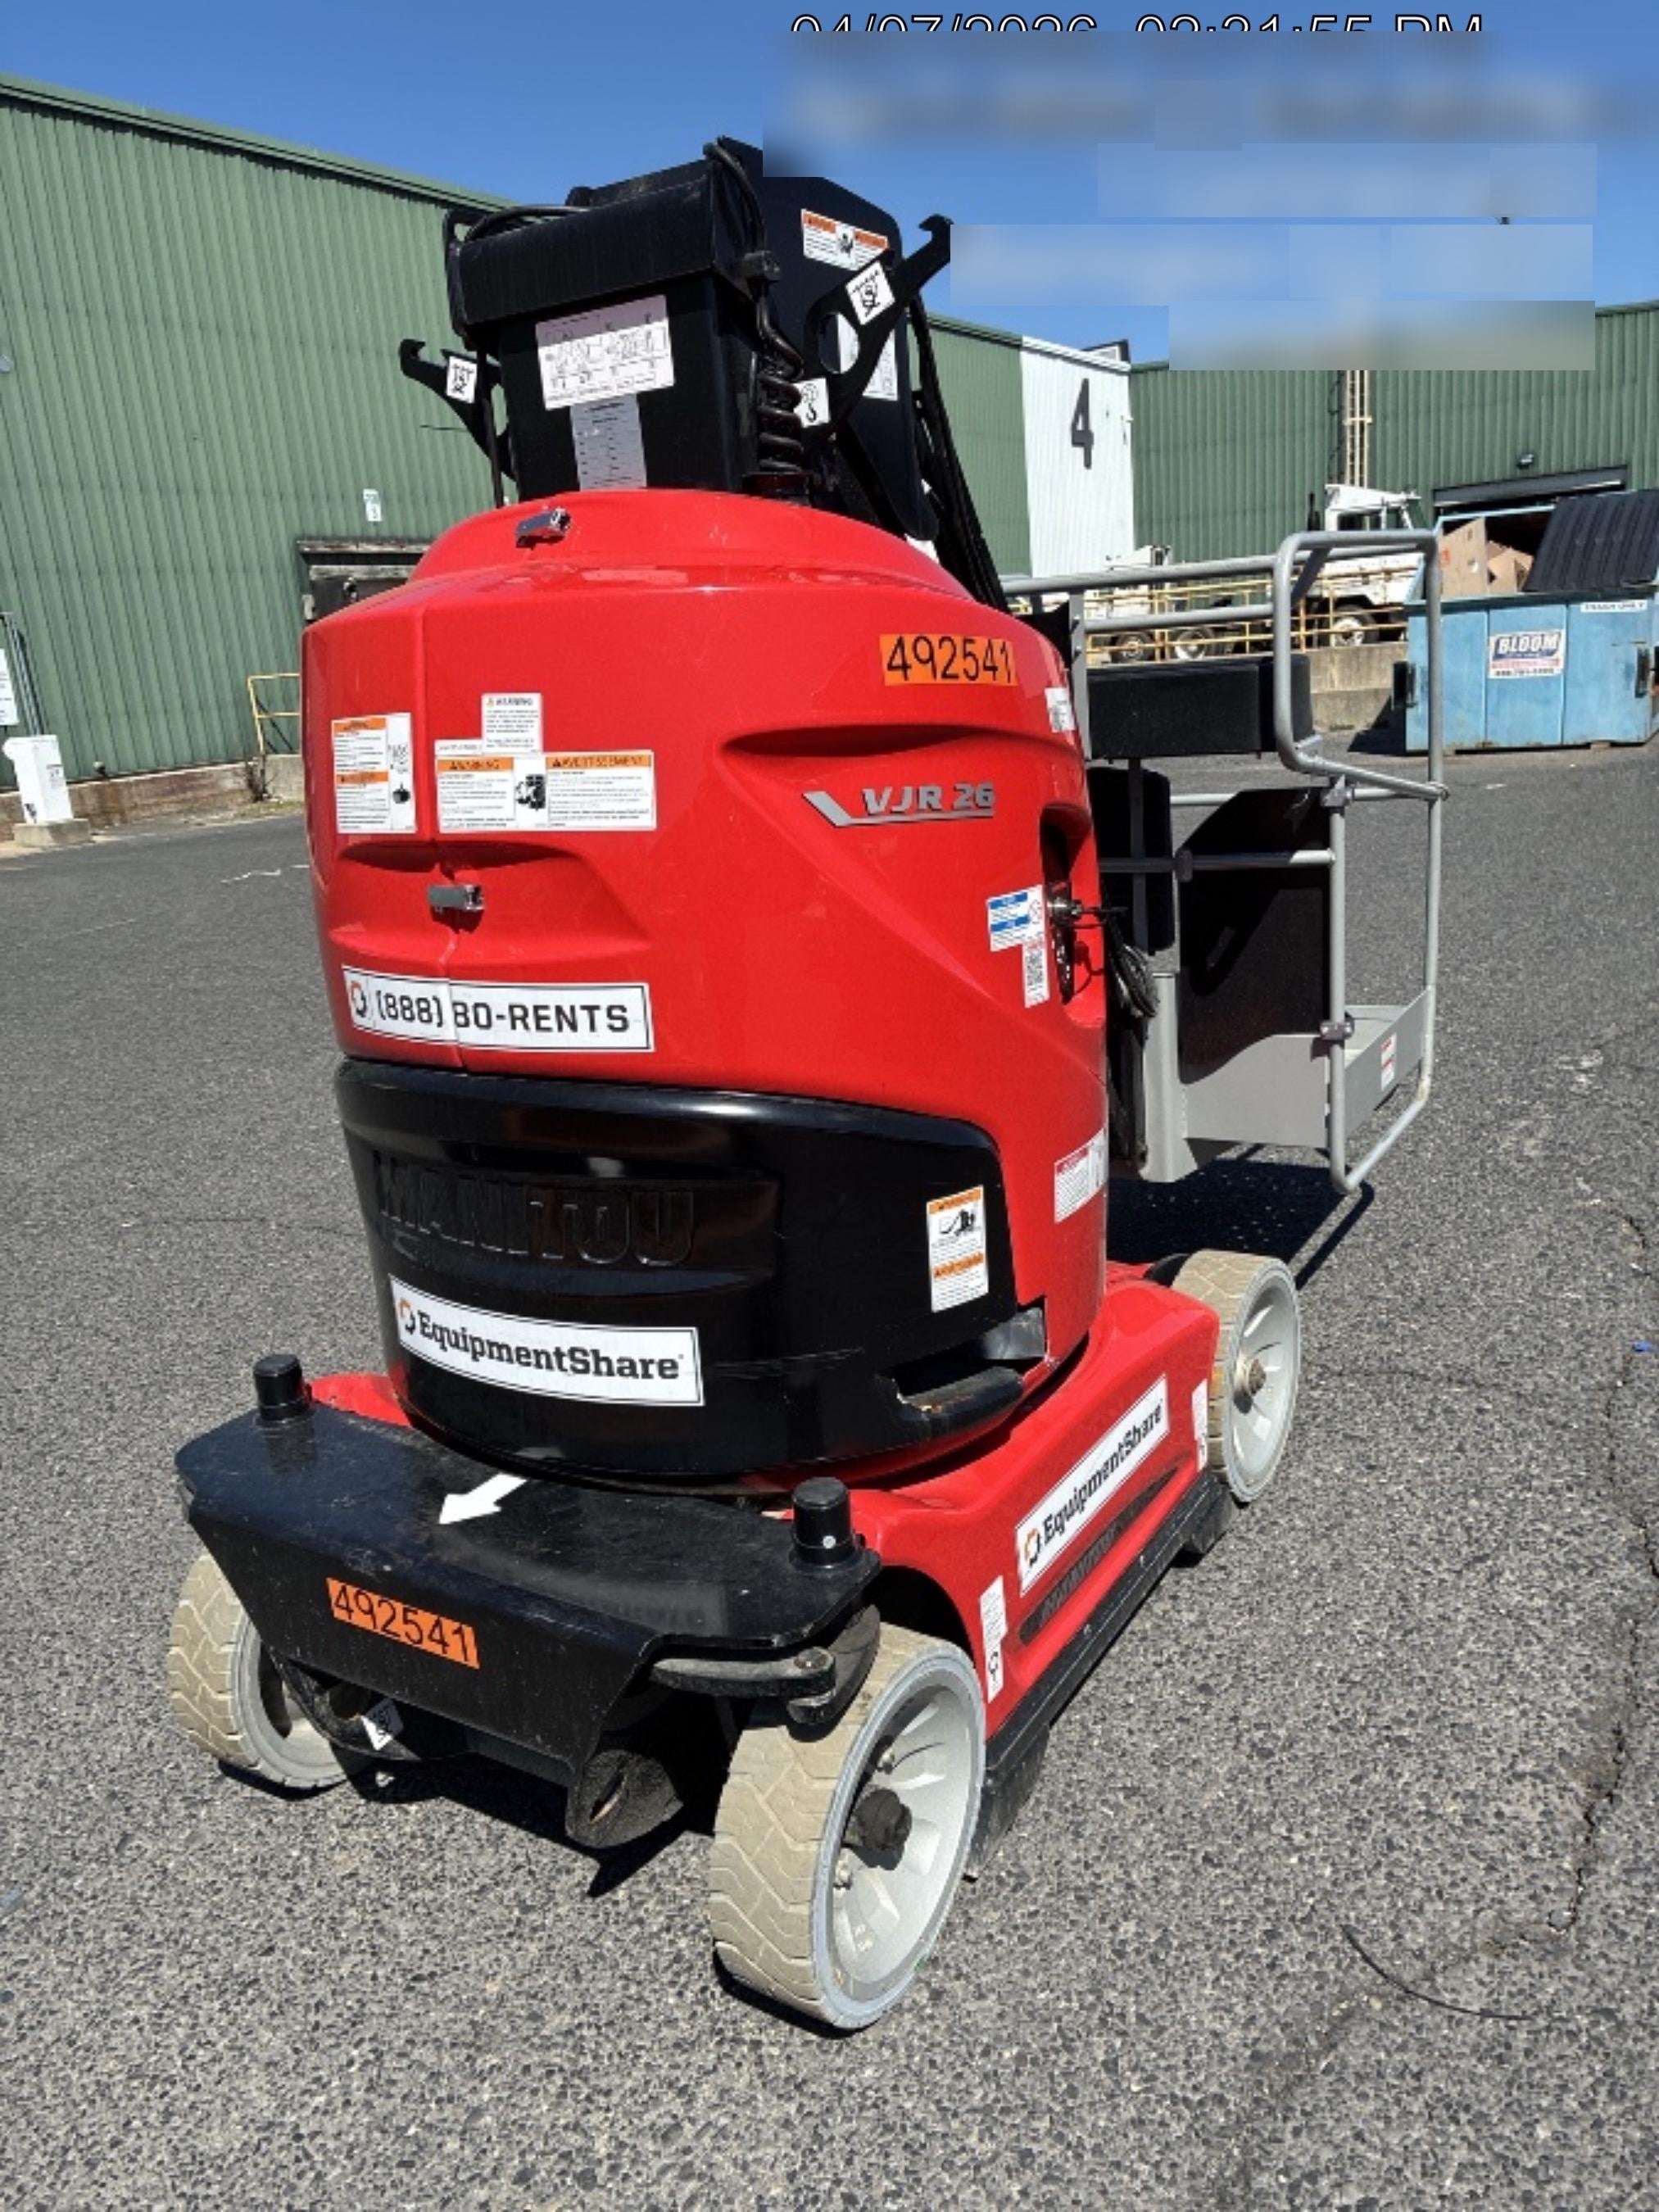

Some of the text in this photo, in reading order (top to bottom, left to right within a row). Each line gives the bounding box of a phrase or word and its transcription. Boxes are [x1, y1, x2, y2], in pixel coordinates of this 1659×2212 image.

[1071, 378, 1095, 470] 4
[886, 635, 1012, 683] 492541
[1498, 632, 1561, 655] BLOOM
[863, 782, 996, 816] VJR 26
[377, 990, 444, 1028] (888)
[417, 1309, 680, 1380] EquipmentShare
[1041, 1406, 1163, 1543] EquipmentShare
[333, 1584, 469, 1662] 492541
